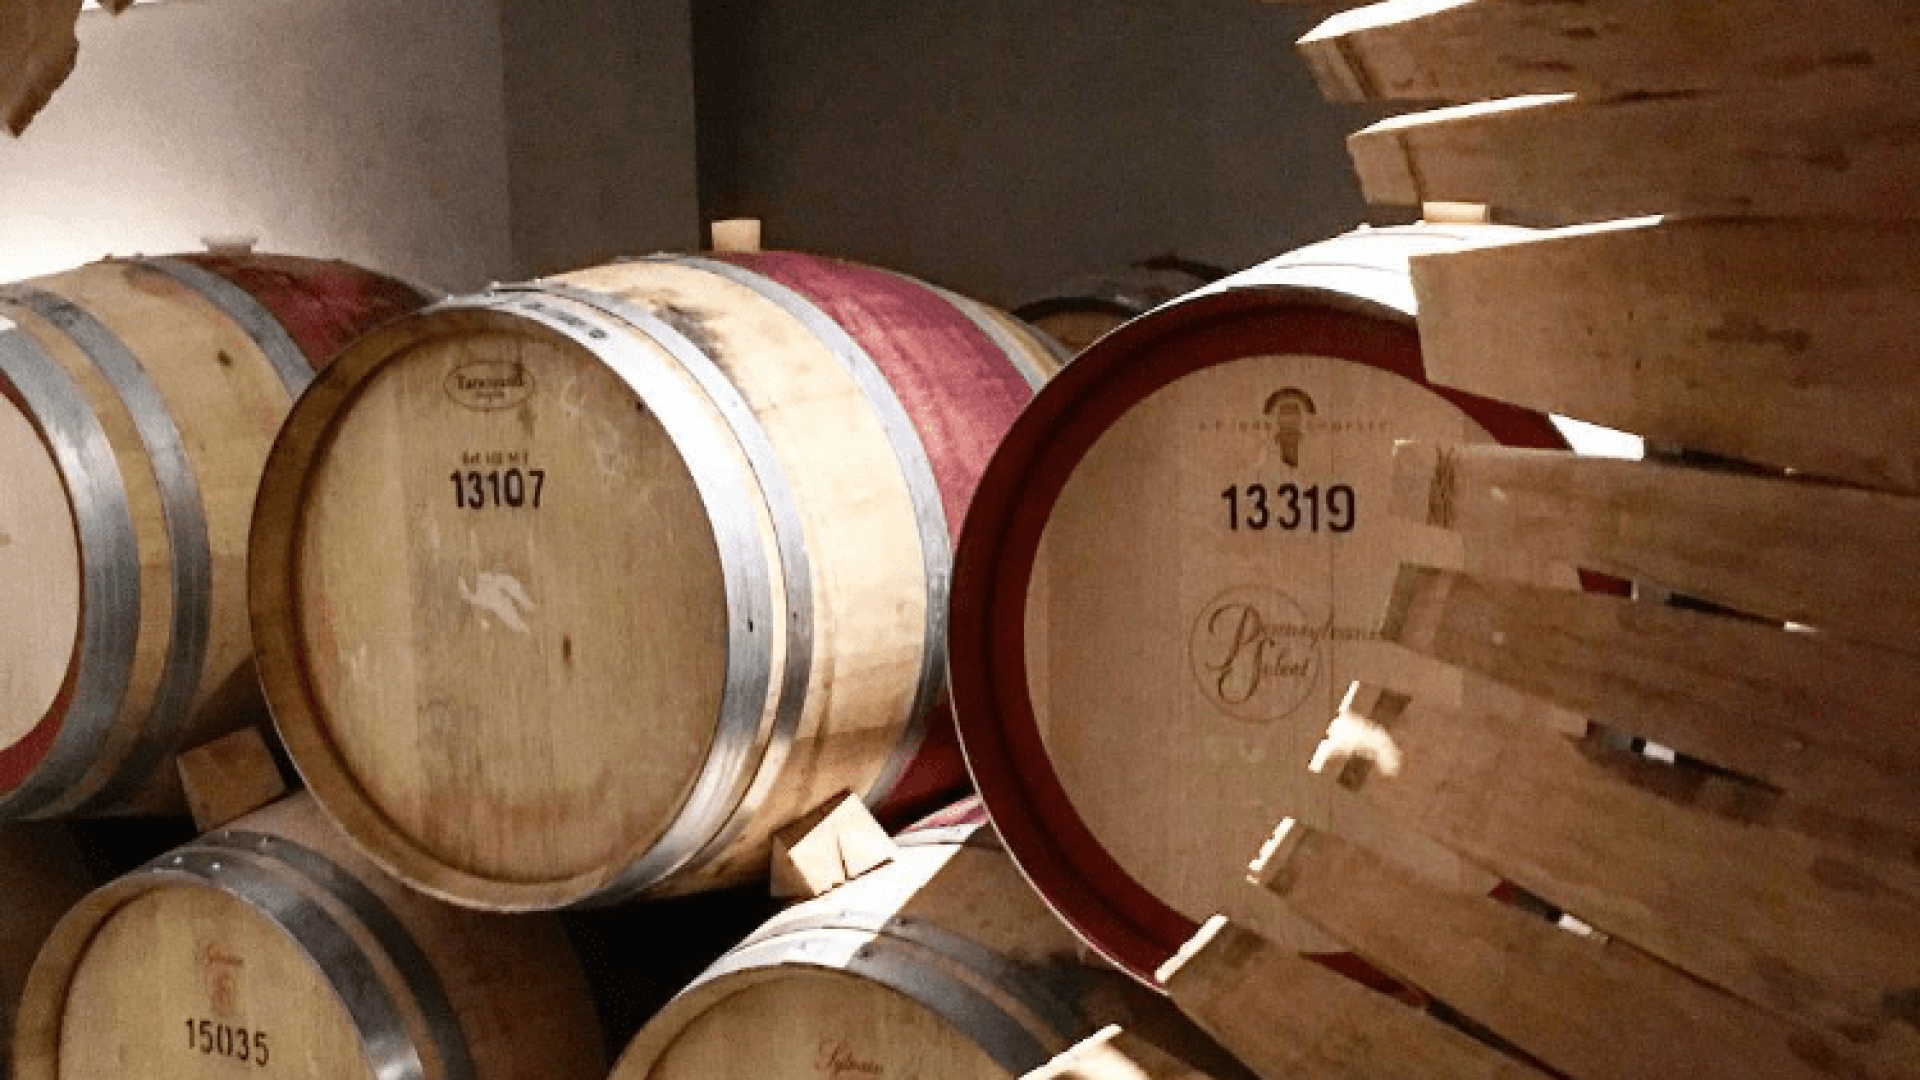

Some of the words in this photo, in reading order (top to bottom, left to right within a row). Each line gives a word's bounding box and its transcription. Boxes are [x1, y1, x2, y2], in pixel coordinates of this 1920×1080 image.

[450, 468, 545, 509] 13107
[1221, 483, 1356, 533] 13319
[184, 1018, 269, 1067] 15035
